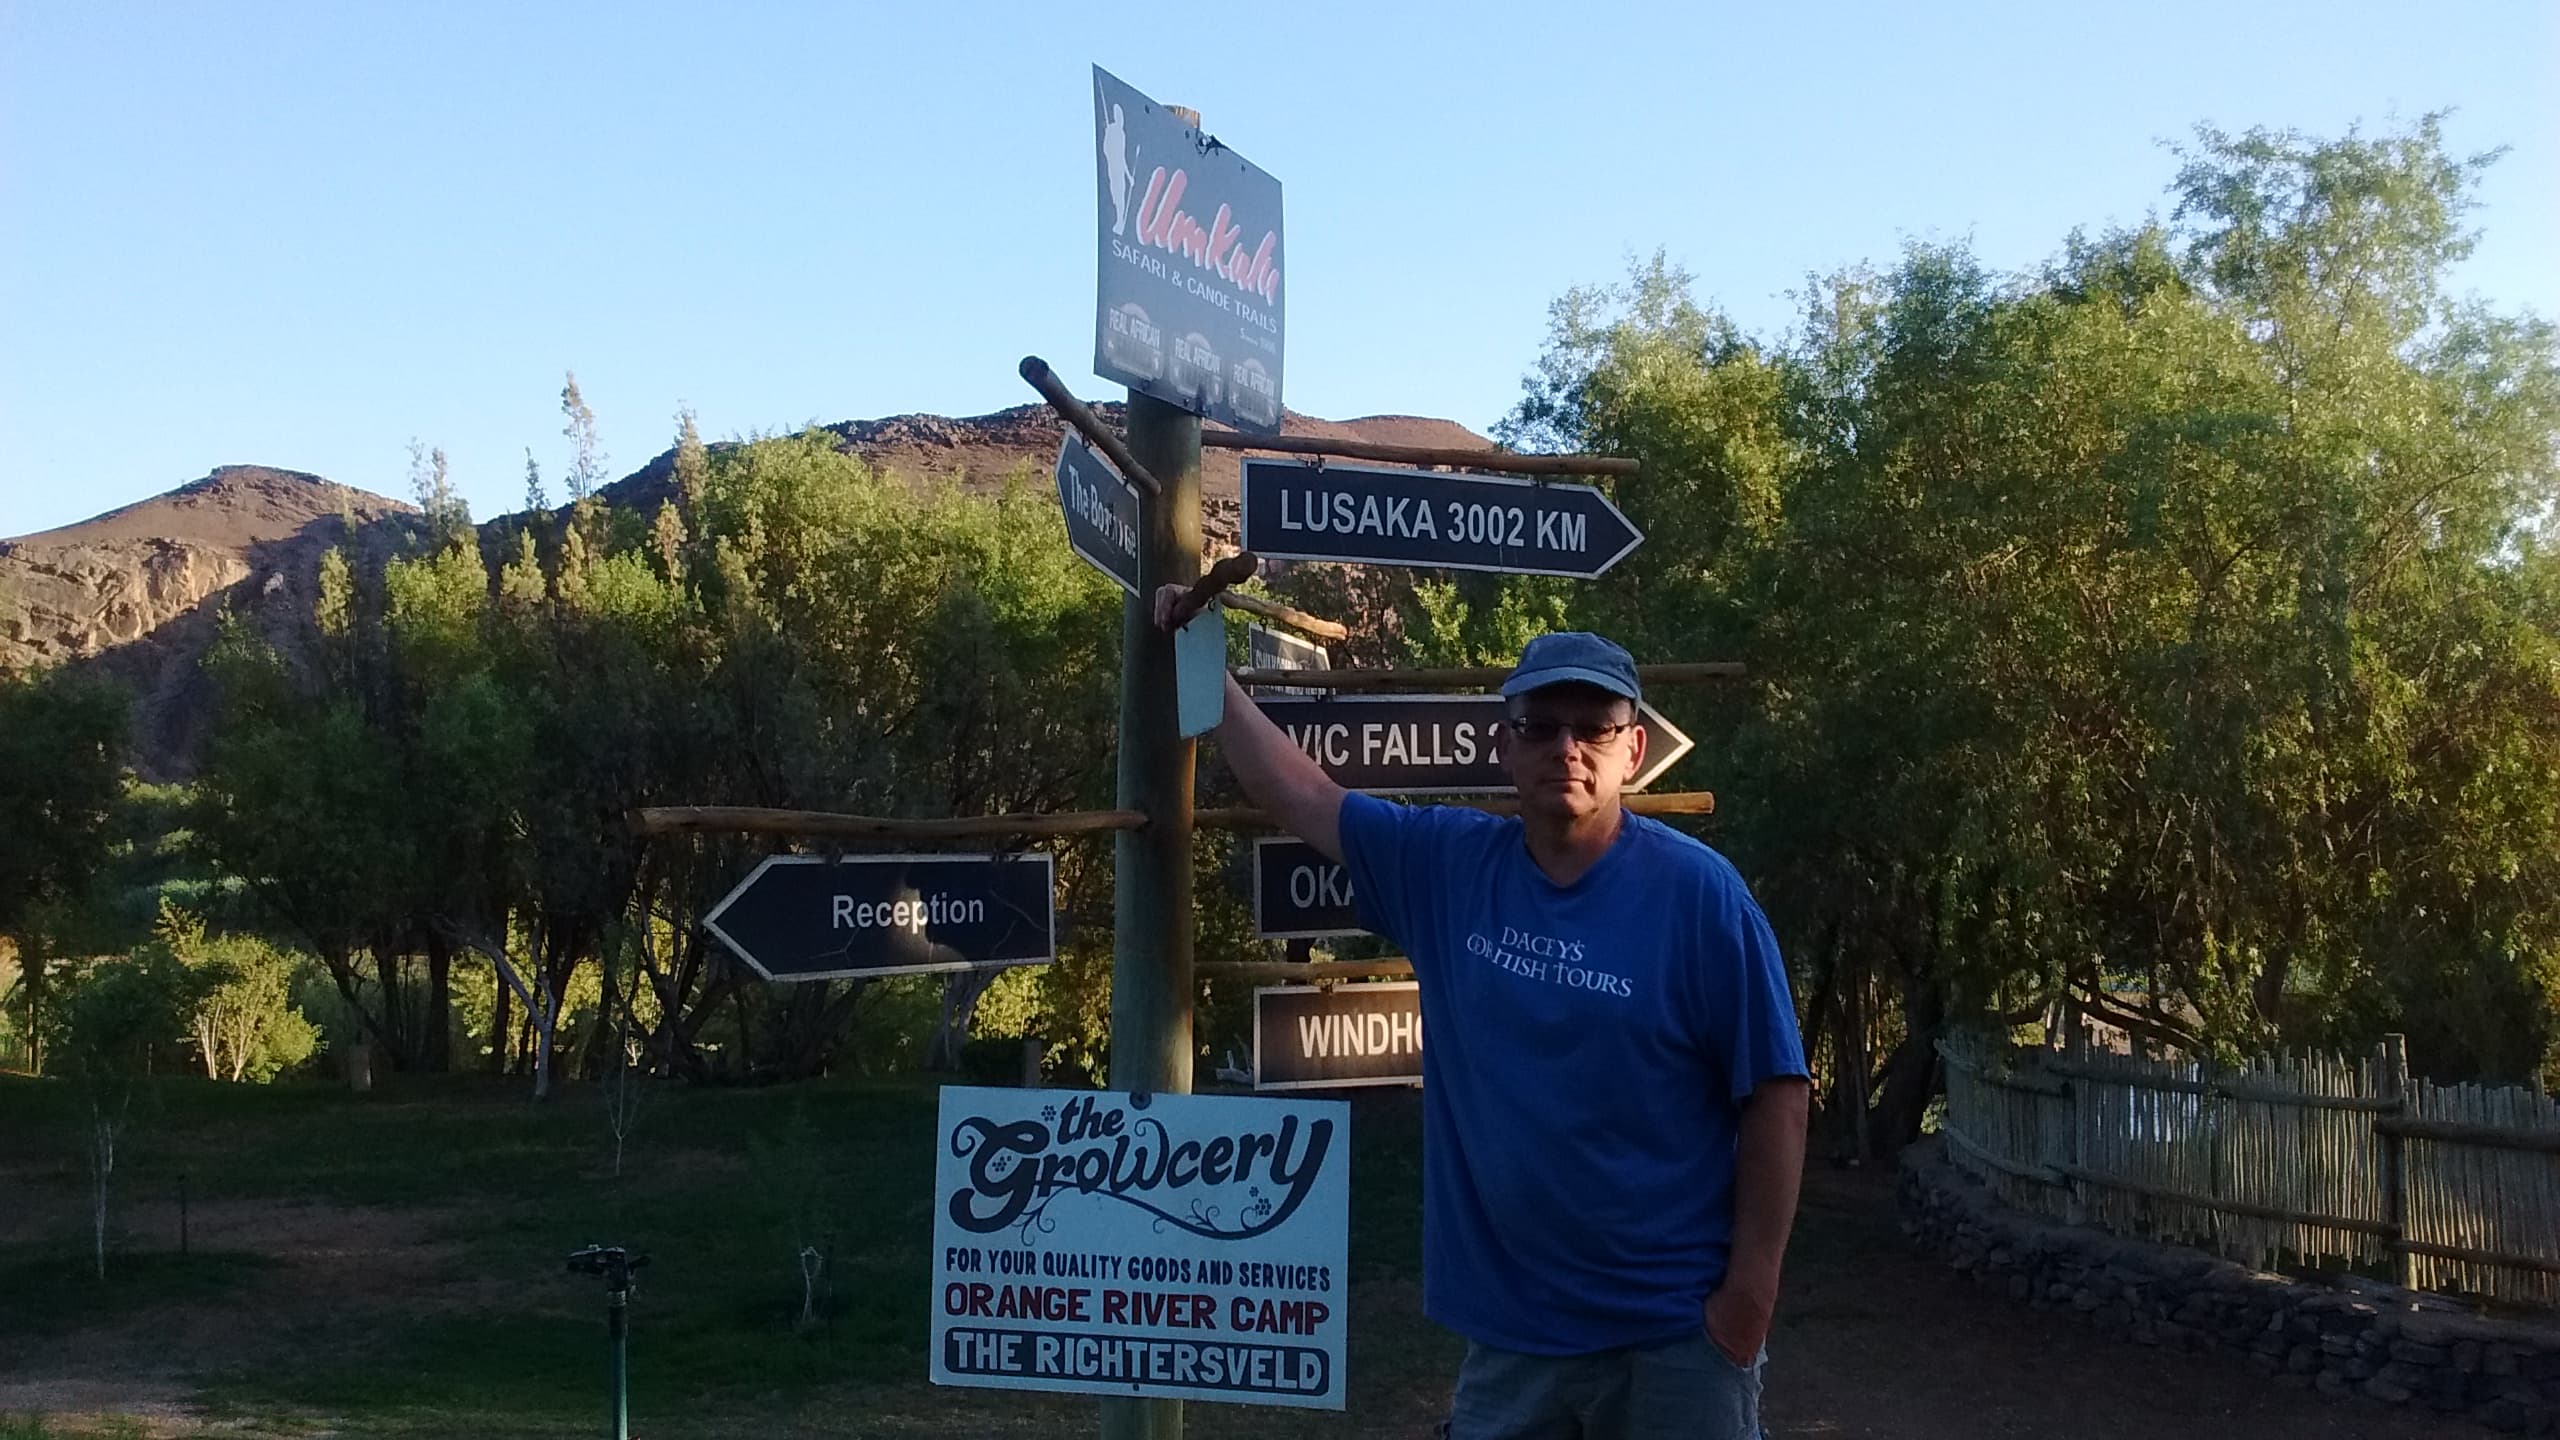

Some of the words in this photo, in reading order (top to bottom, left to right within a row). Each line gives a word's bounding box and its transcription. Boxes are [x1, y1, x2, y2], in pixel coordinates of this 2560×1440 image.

[1112, 239, 1166, 280] SAFARI
[1171, 270, 1183, 288] &
[1187, 277, 1230, 312] CANOE
[1234, 300, 1277, 334] TRAILS
[1068, 463, 1089, 520] The
[1281, 489, 1438, 540] LUSAKA
[1448, 502, 1525, 547] 3002
[1536, 510, 1587, 553] KM
[1287, 723, 1350, 766] VIC
[1362, 723, 1476, 765] FALLS
[832, 892, 985, 935] Reception
[1553, 962, 1633, 998] TOURS
[1057, 1095, 1126, 1141] the
[946, 1247, 982, 1274] FOR
[987, 1250, 1036, 1277] YOUR
[1042, 1252, 1123, 1281] QUALITY
[1127, 1256, 1191, 1285] GOODS
[1197, 1260, 1233, 1287] AND
[1238, 1262, 1331, 1293] SERVICES
[945, 1282, 1091, 1323] ORANGE
[1103, 1289, 1217, 1331] RIVER
[1230, 1296, 1331, 1336] CAMP
[952, 1331, 1023, 1372] THE
[1035, 1335, 1323, 1392] RICHTERSVELD
